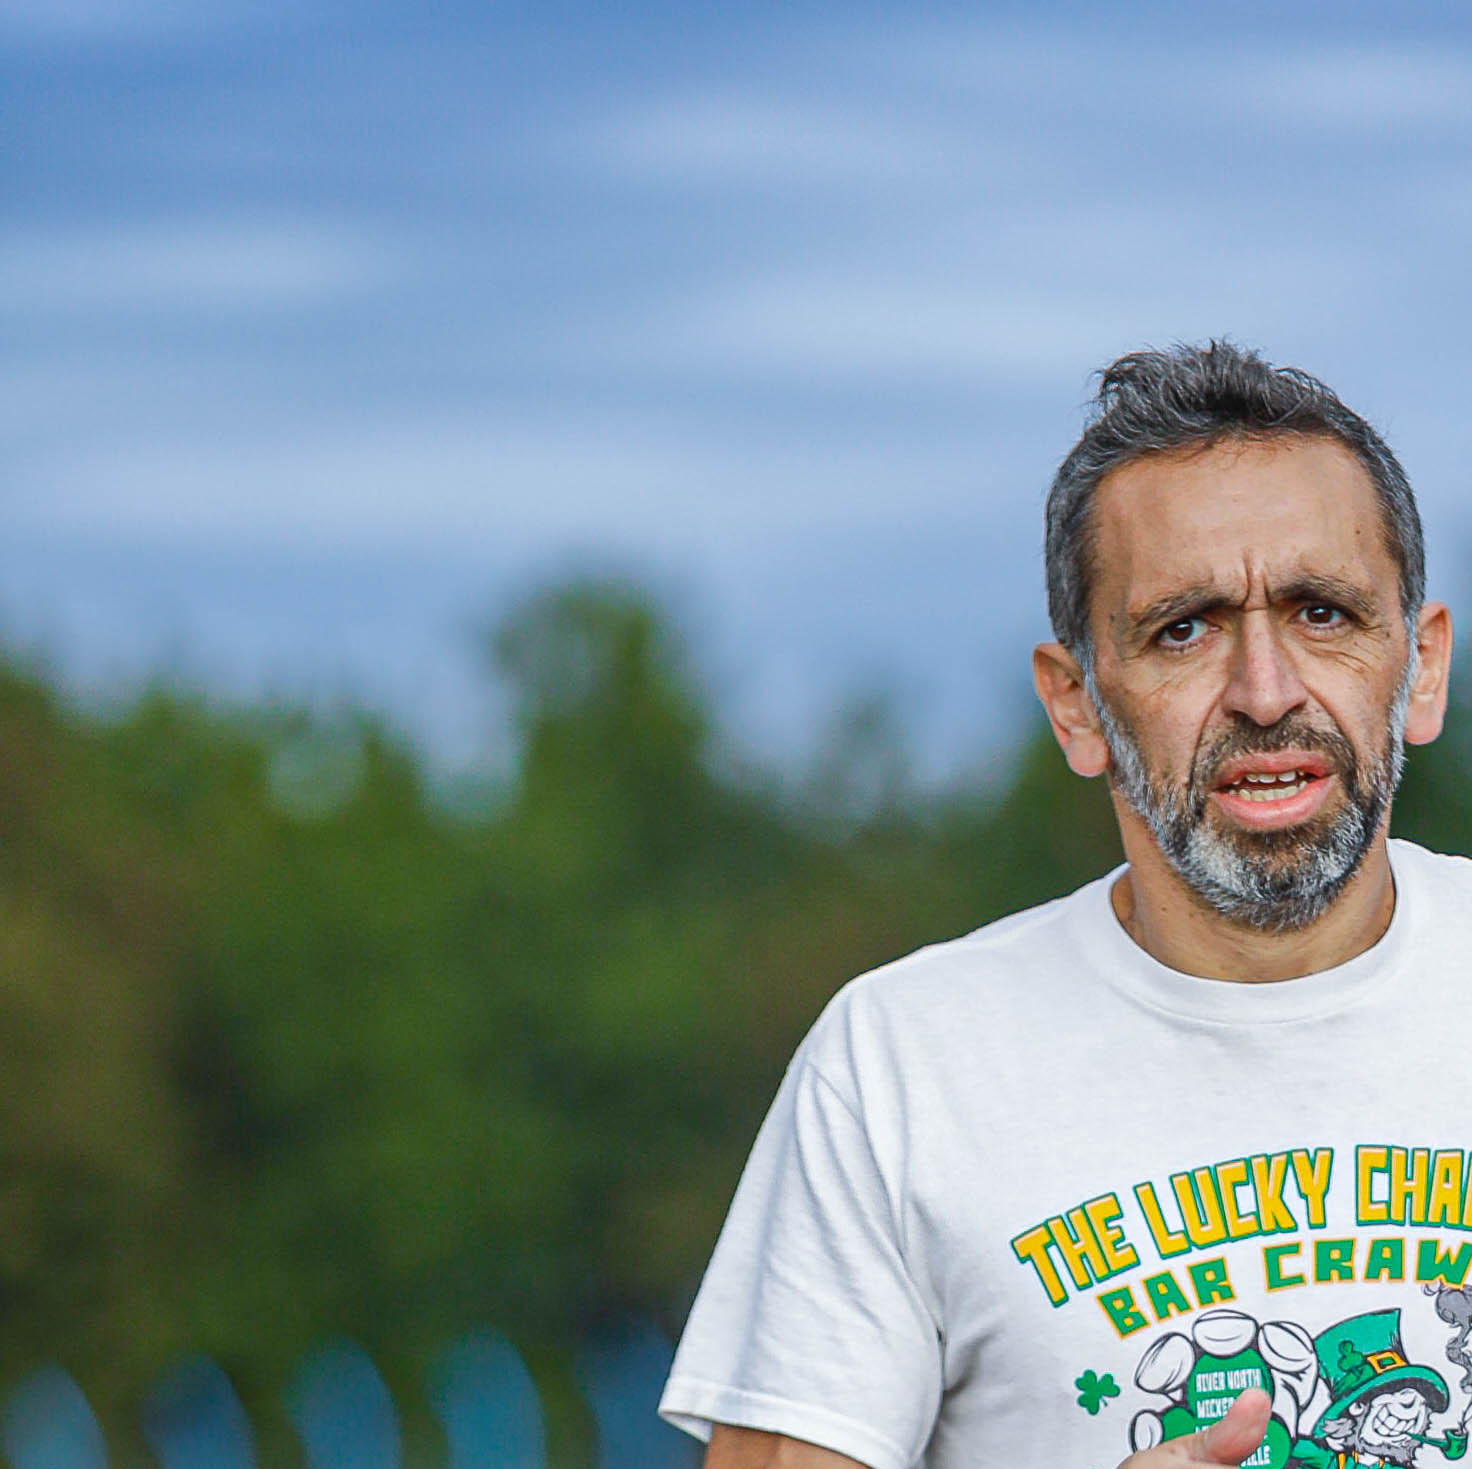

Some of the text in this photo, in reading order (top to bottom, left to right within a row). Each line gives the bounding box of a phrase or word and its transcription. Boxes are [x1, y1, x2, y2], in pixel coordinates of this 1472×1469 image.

[1011, 1192, 1141, 1307] THE
[1133, 1147, 1334, 1259] LUCKY
[1096, 1255, 1236, 1340] BAR
[1196, 1368, 1262, 1392] RIVER NORTH
